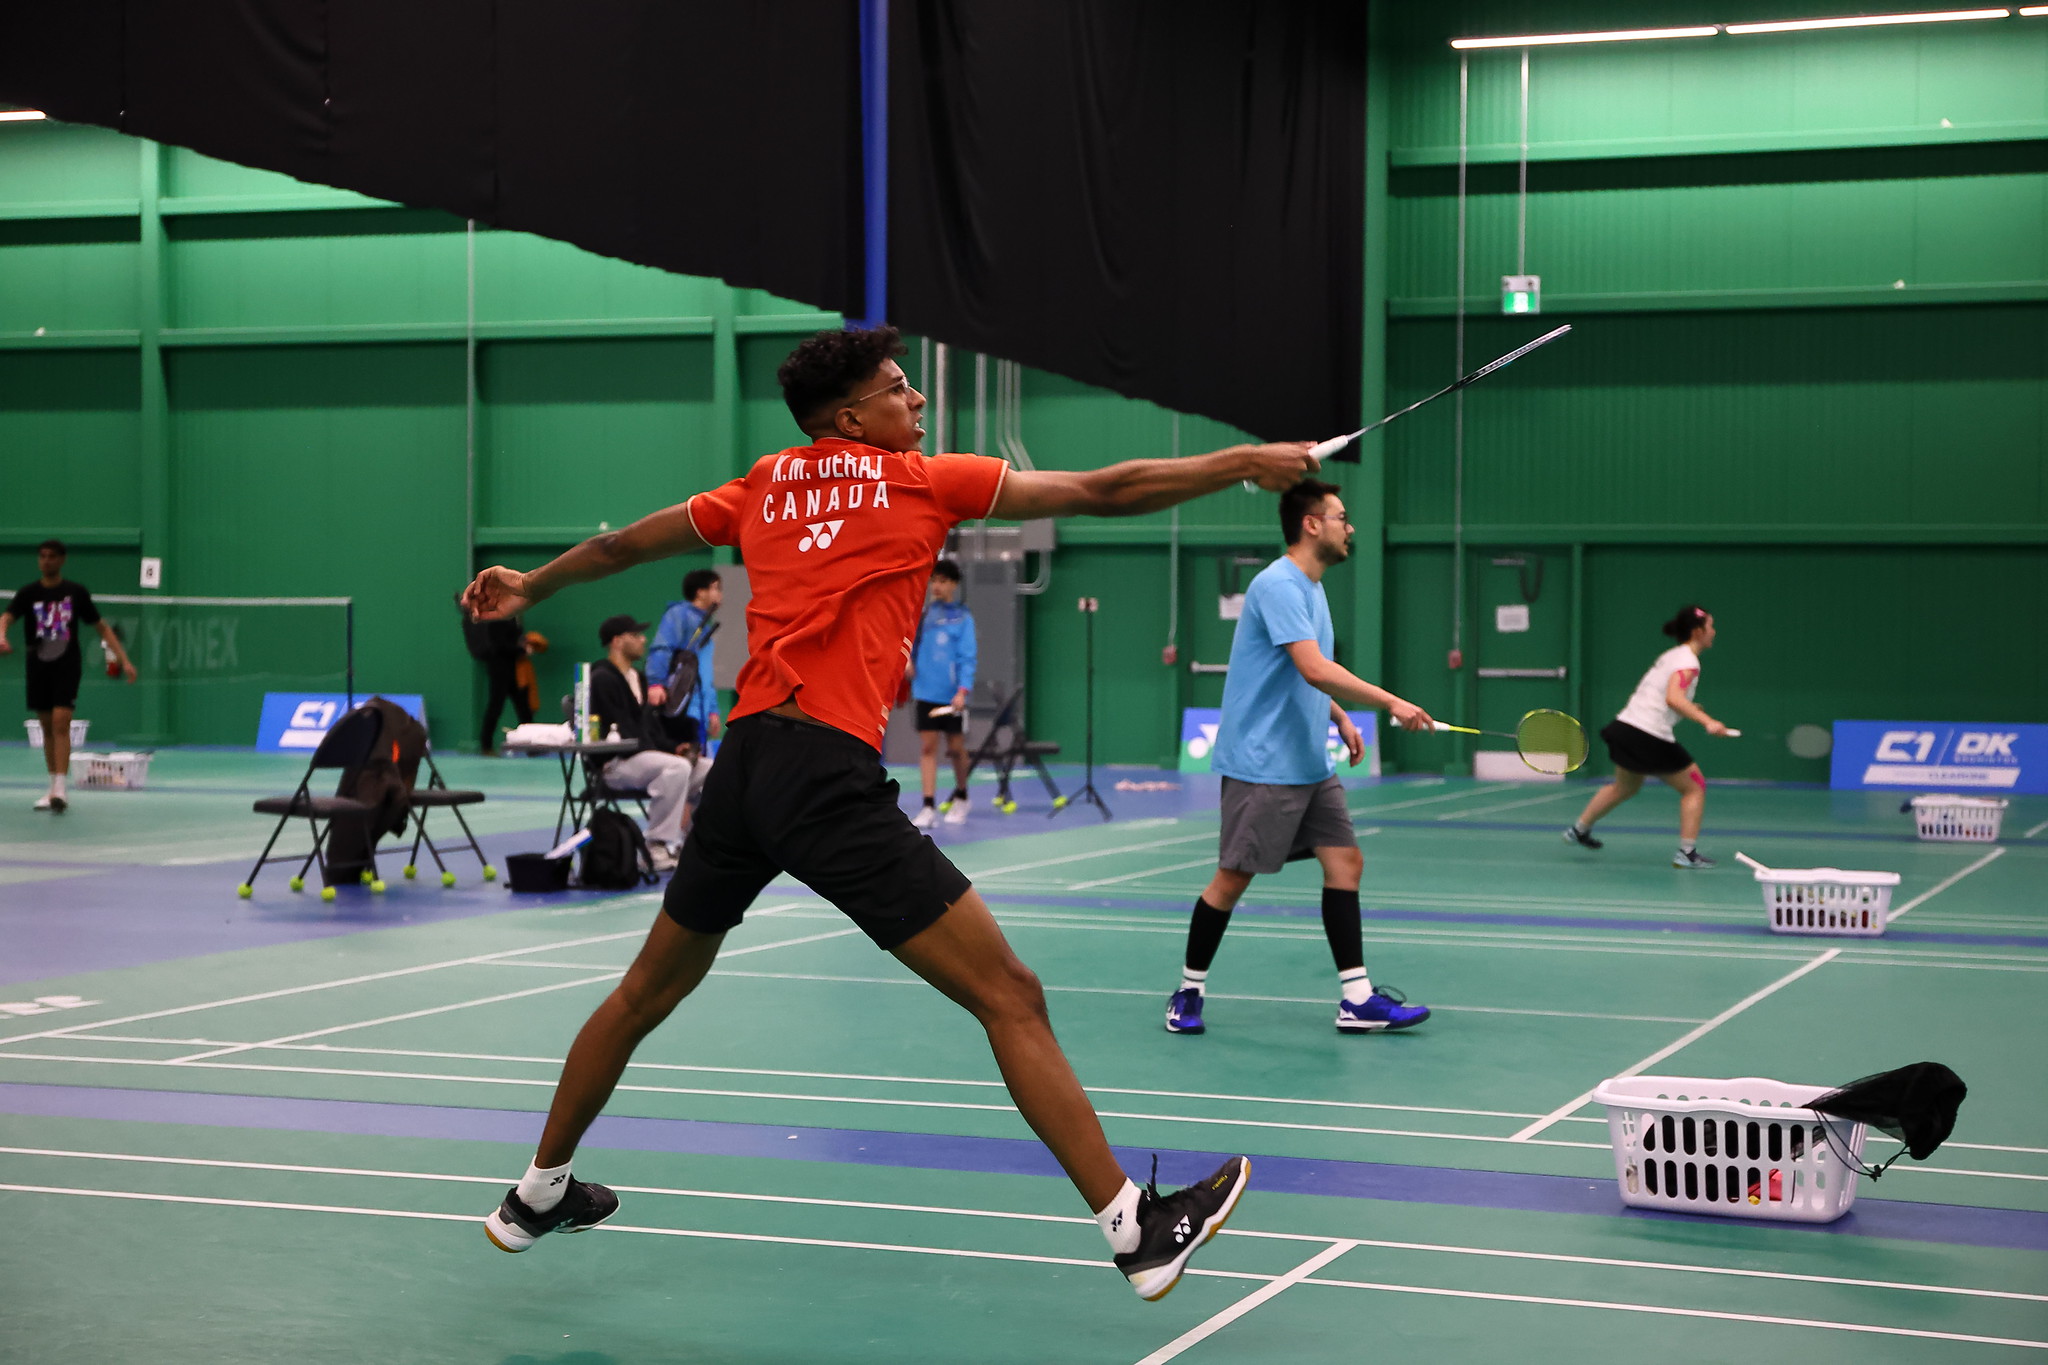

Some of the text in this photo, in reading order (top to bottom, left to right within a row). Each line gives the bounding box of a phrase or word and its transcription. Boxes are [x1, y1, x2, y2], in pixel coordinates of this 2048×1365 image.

[773, 451, 882, 482] K.M. DERAJ
[763, 482, 889, 523] CANADA
[148, 618, 237, 669] YONEX
[291, 701, 336, 727] C1
[1876, 731, 2017, 761] C1 DK
